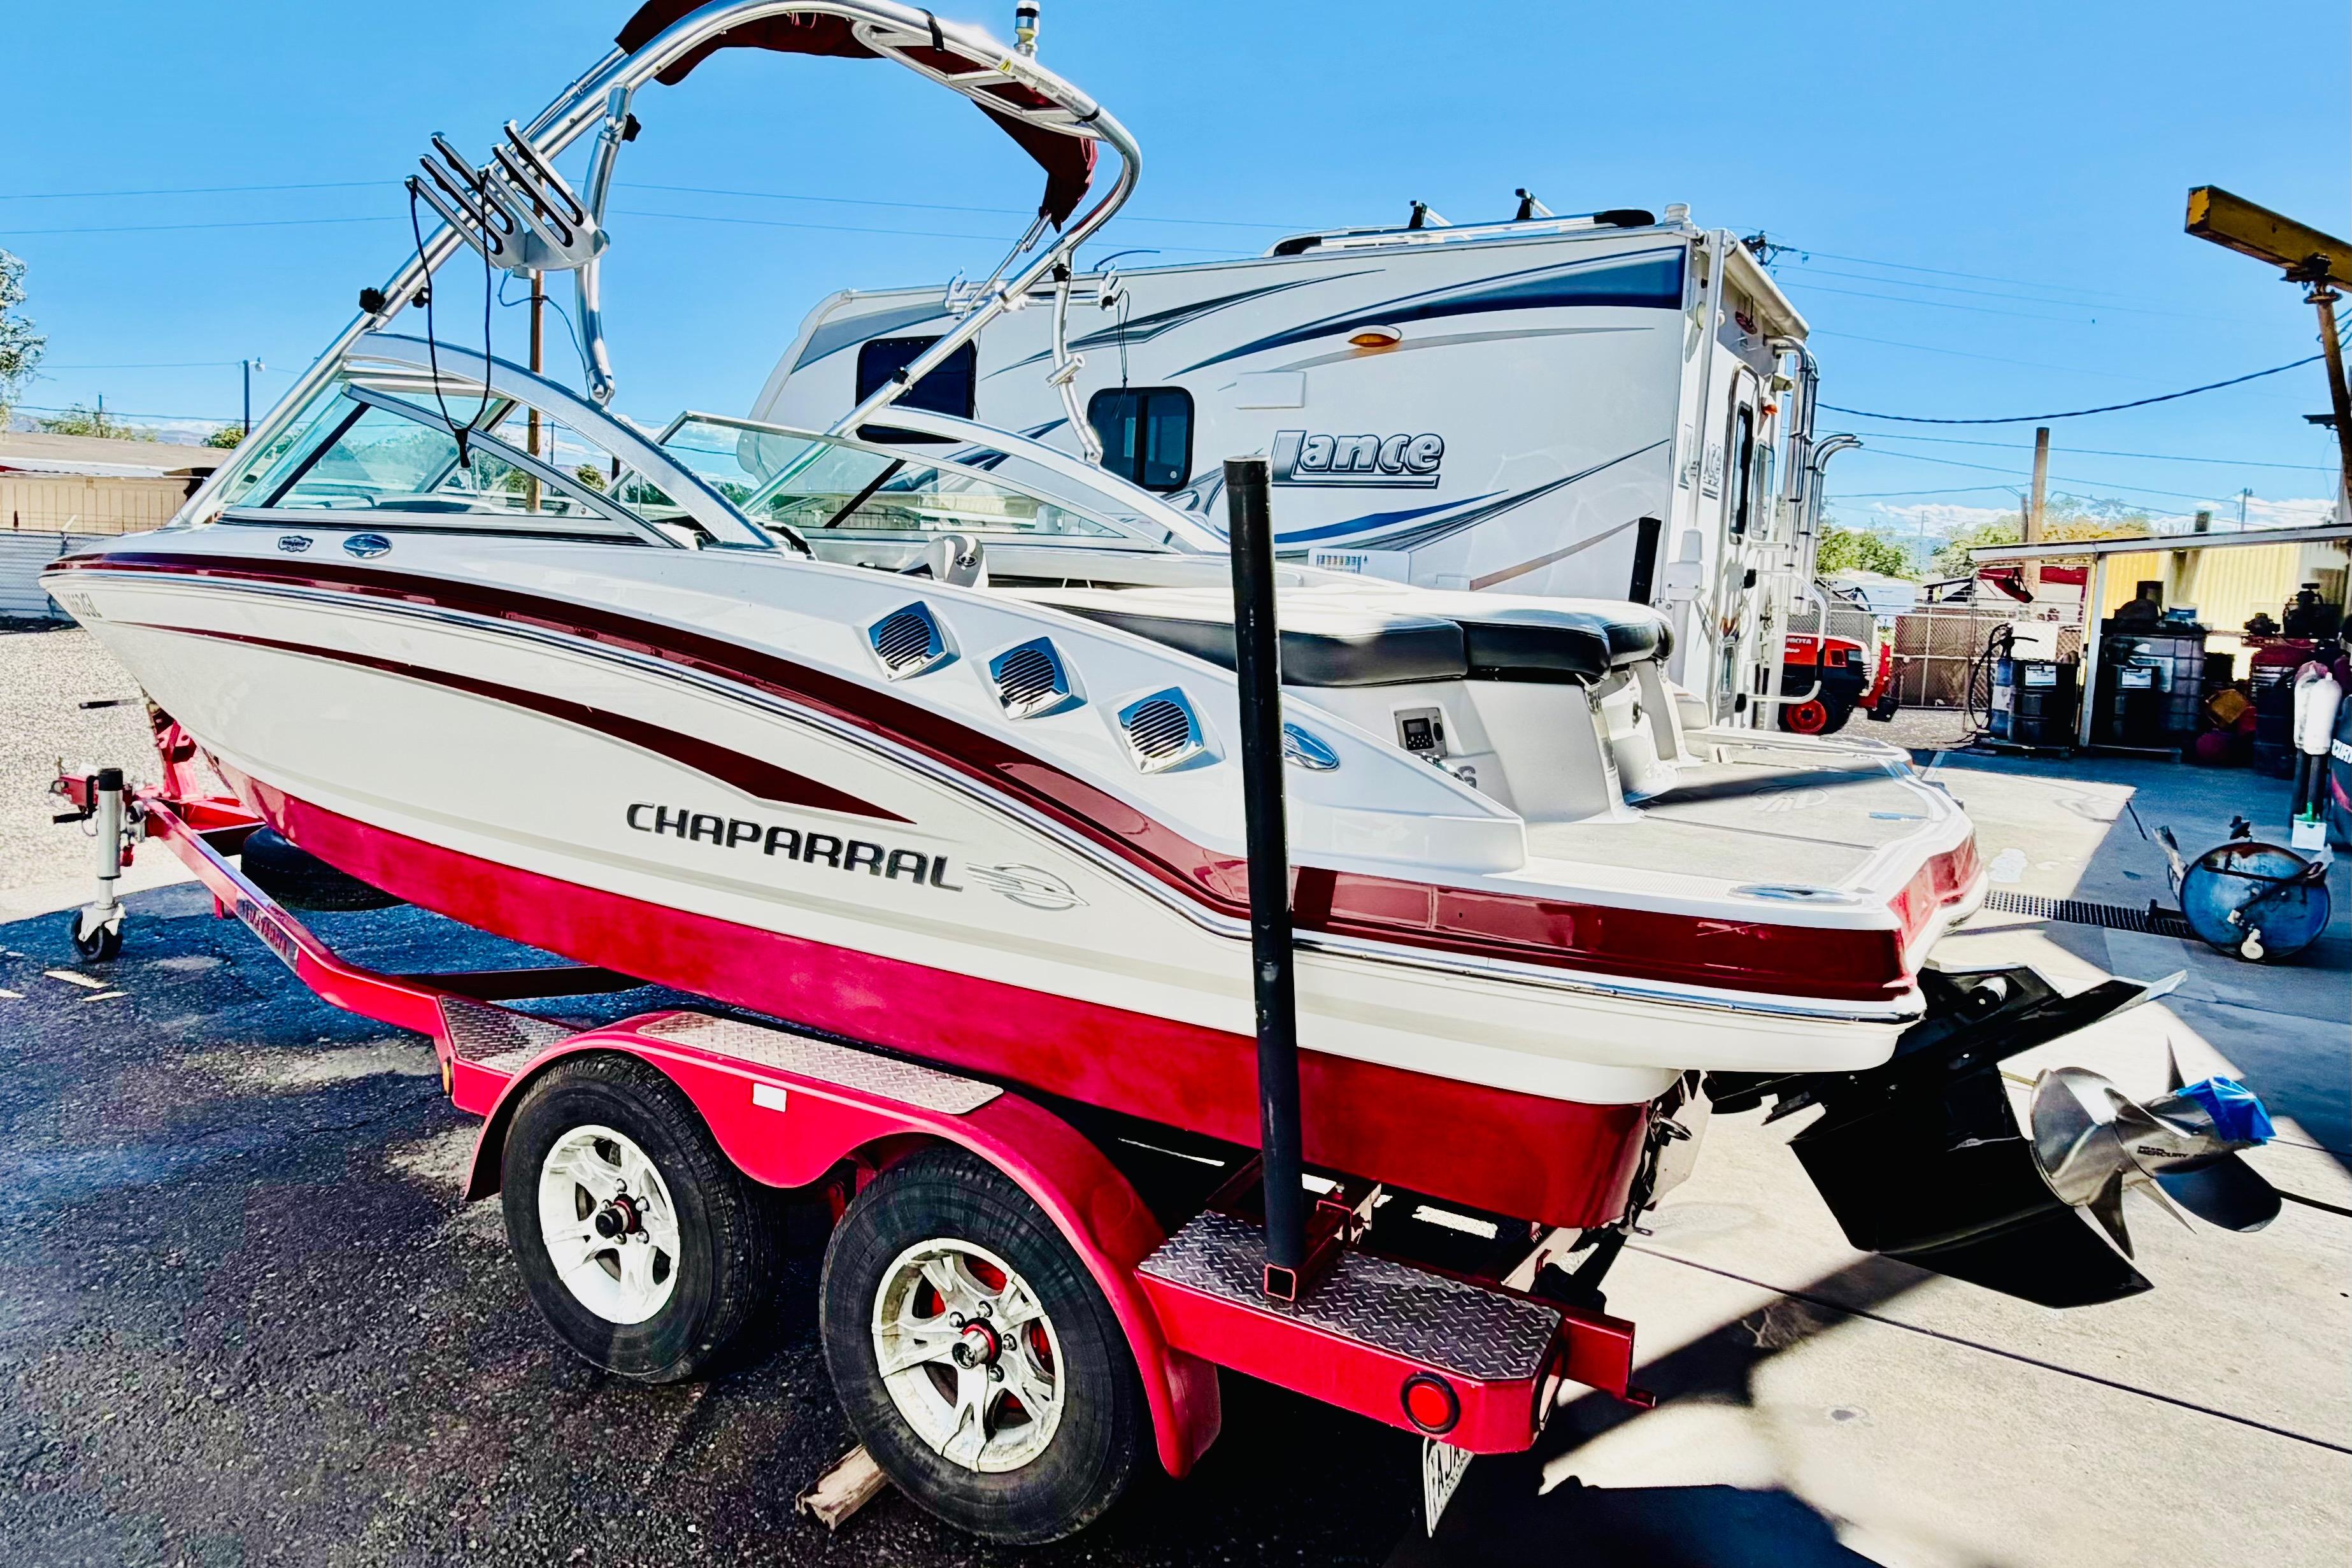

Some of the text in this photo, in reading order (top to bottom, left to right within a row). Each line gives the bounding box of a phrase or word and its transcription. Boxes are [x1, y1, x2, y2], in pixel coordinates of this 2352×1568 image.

[1271, 430, 1445, 489] Lance
[626, 801, 964, 892] CHAPARRAL
[2137, 1148, 2189, 1157] MERCURY
